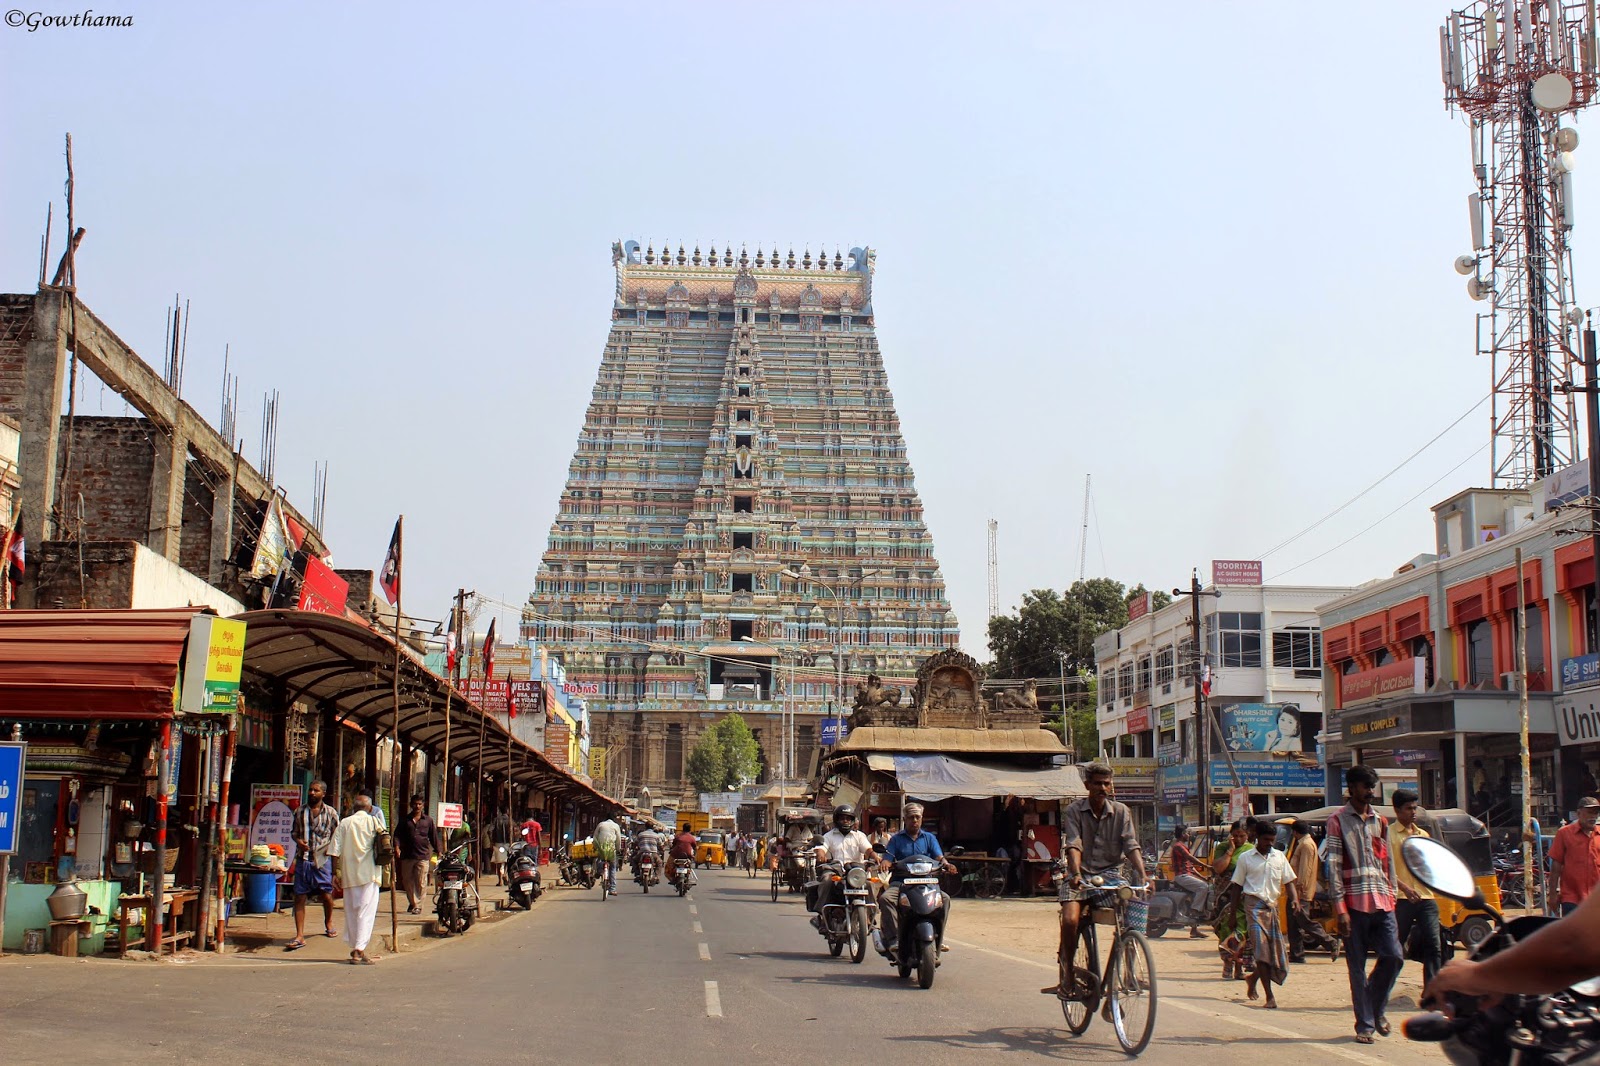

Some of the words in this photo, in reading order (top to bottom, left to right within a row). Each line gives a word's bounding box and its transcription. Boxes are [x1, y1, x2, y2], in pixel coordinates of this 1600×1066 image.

[563, 684, 598, 694] ROOMS
[1380, 677, 1398, 692] ICICI
[1398, 673, 1414, 688] Bank
[1370, 716, 1397, 732] COMPLEX
